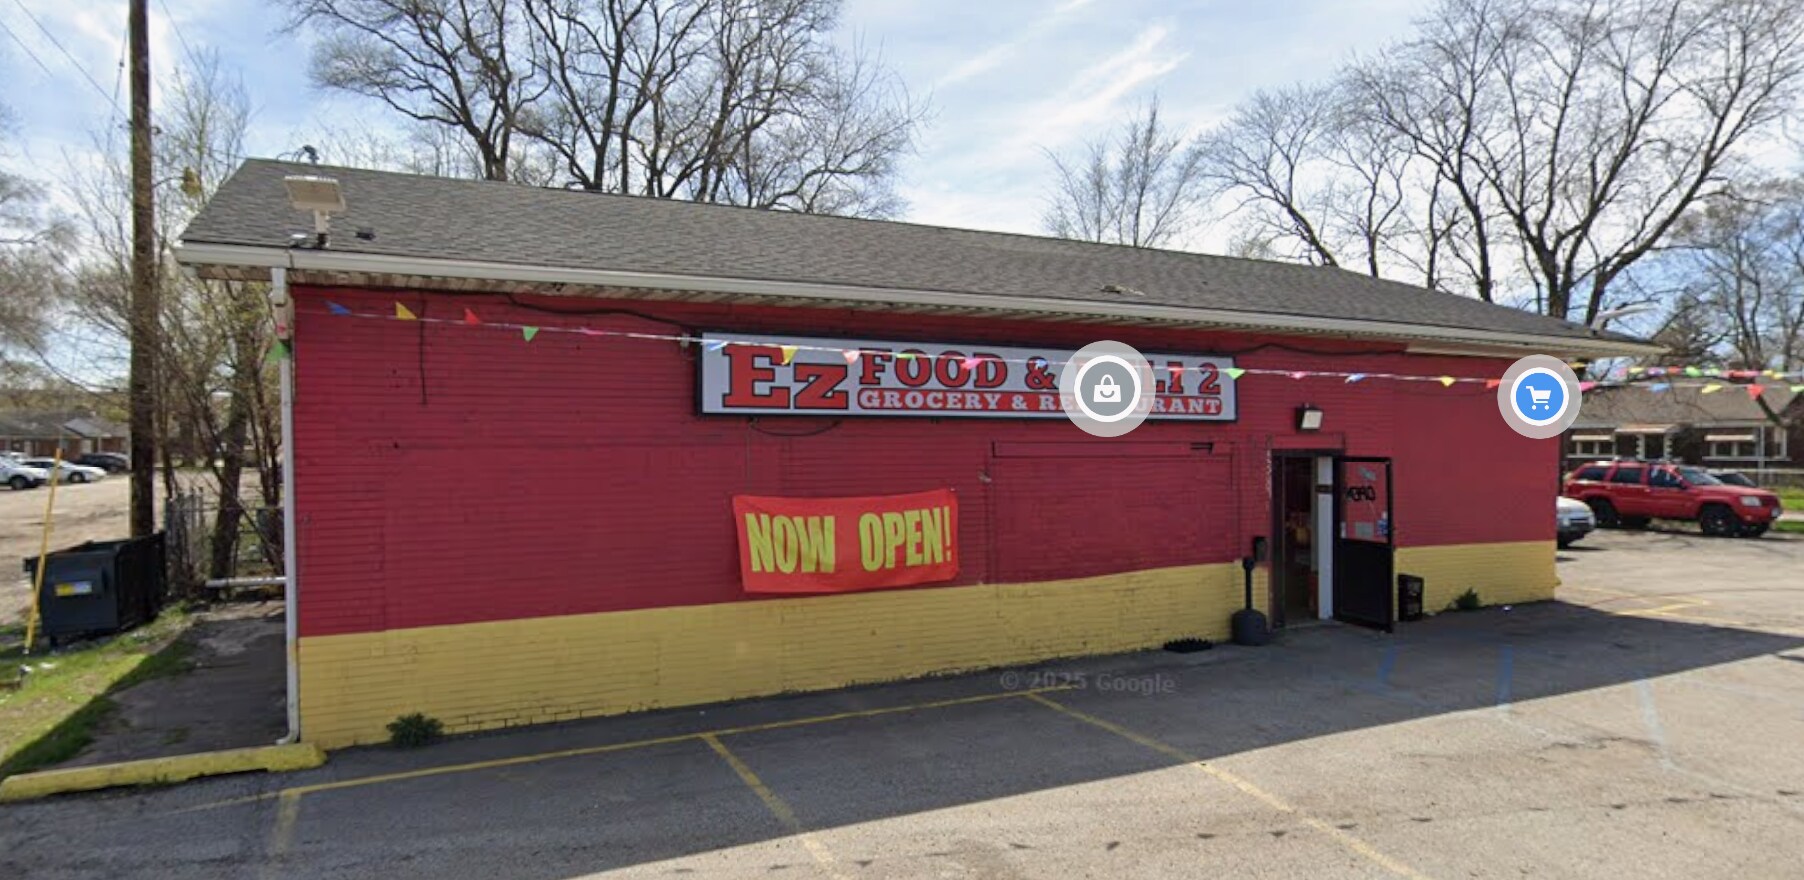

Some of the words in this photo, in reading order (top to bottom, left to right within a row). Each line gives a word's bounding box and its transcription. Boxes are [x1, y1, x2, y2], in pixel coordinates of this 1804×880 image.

[859, 347, 1008, 389] FOOD
[1024, 355, 1058, 390] &
[1198, 362, 1221, 394] 2
[859, 390, 1001, 410] GROCERY
[1011, 394, 1028, 410] &
[1039, 394, 1220, 414] REURANT
[745, 512, 836, 574] NOW
[858, 505, 952, 572] OPEN!
